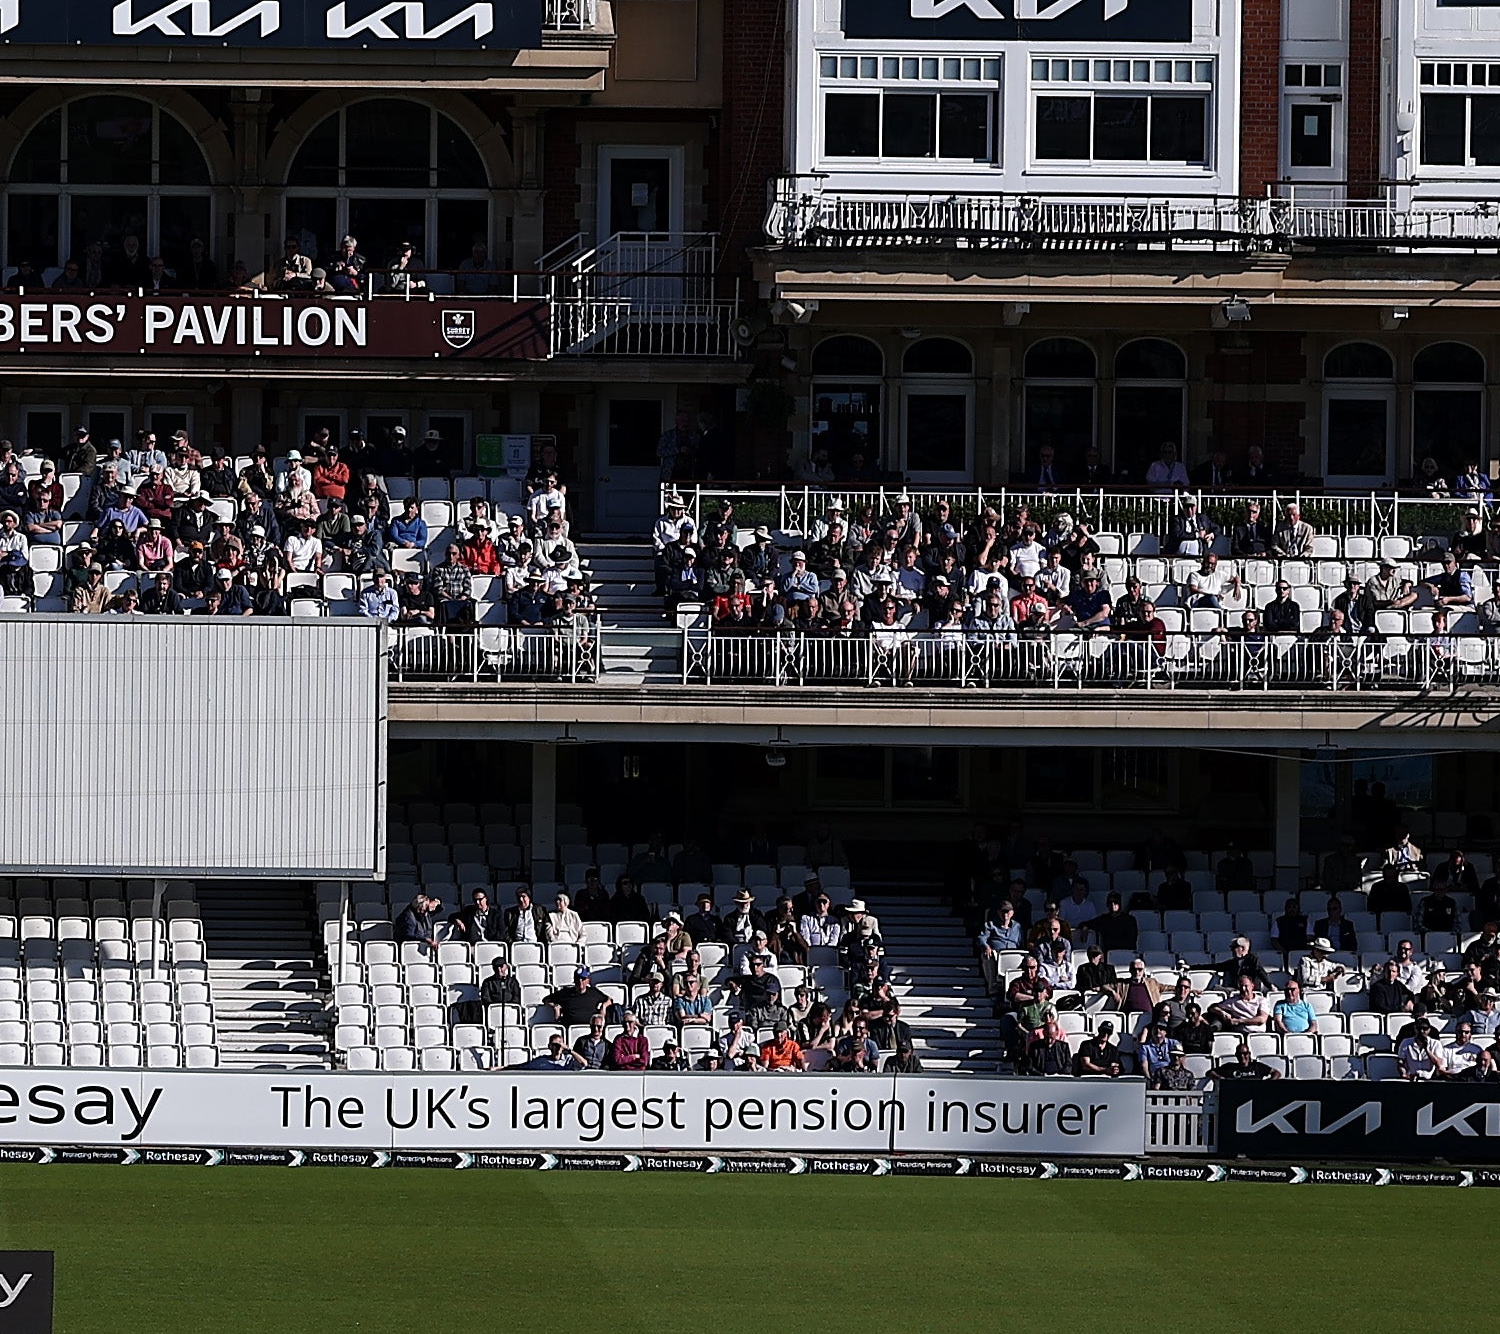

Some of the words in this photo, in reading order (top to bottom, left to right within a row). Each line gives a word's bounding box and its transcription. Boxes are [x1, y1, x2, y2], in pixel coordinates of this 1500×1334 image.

[326, 1, 494, 40] KIA
[145, 305, 367, 347] PAVILION
[270, 1084, 364, 1129] The
[511, 1086, 685, 1142] largest
[705, 1088, 906, 1142] pension
[928, 1090, 1108, 1136] insurer
[1235, 1099, 1382, 1135] KIA
[146, 1150, 202, 1163] Rothesay
[312, 1153, 370, 1165] Rothesay
[480, 1155, 538, 1167] Rothesay
[647, 1158, 703, 1169] Rothesay
[813, 1161, 870, 1173] Rothesay
[980, 1163, 1038, 1176] Rothesay
[1147, 1167, 1204, 1179] Rothesay
[1316, 1170, 1372, 1183] Rothesay
